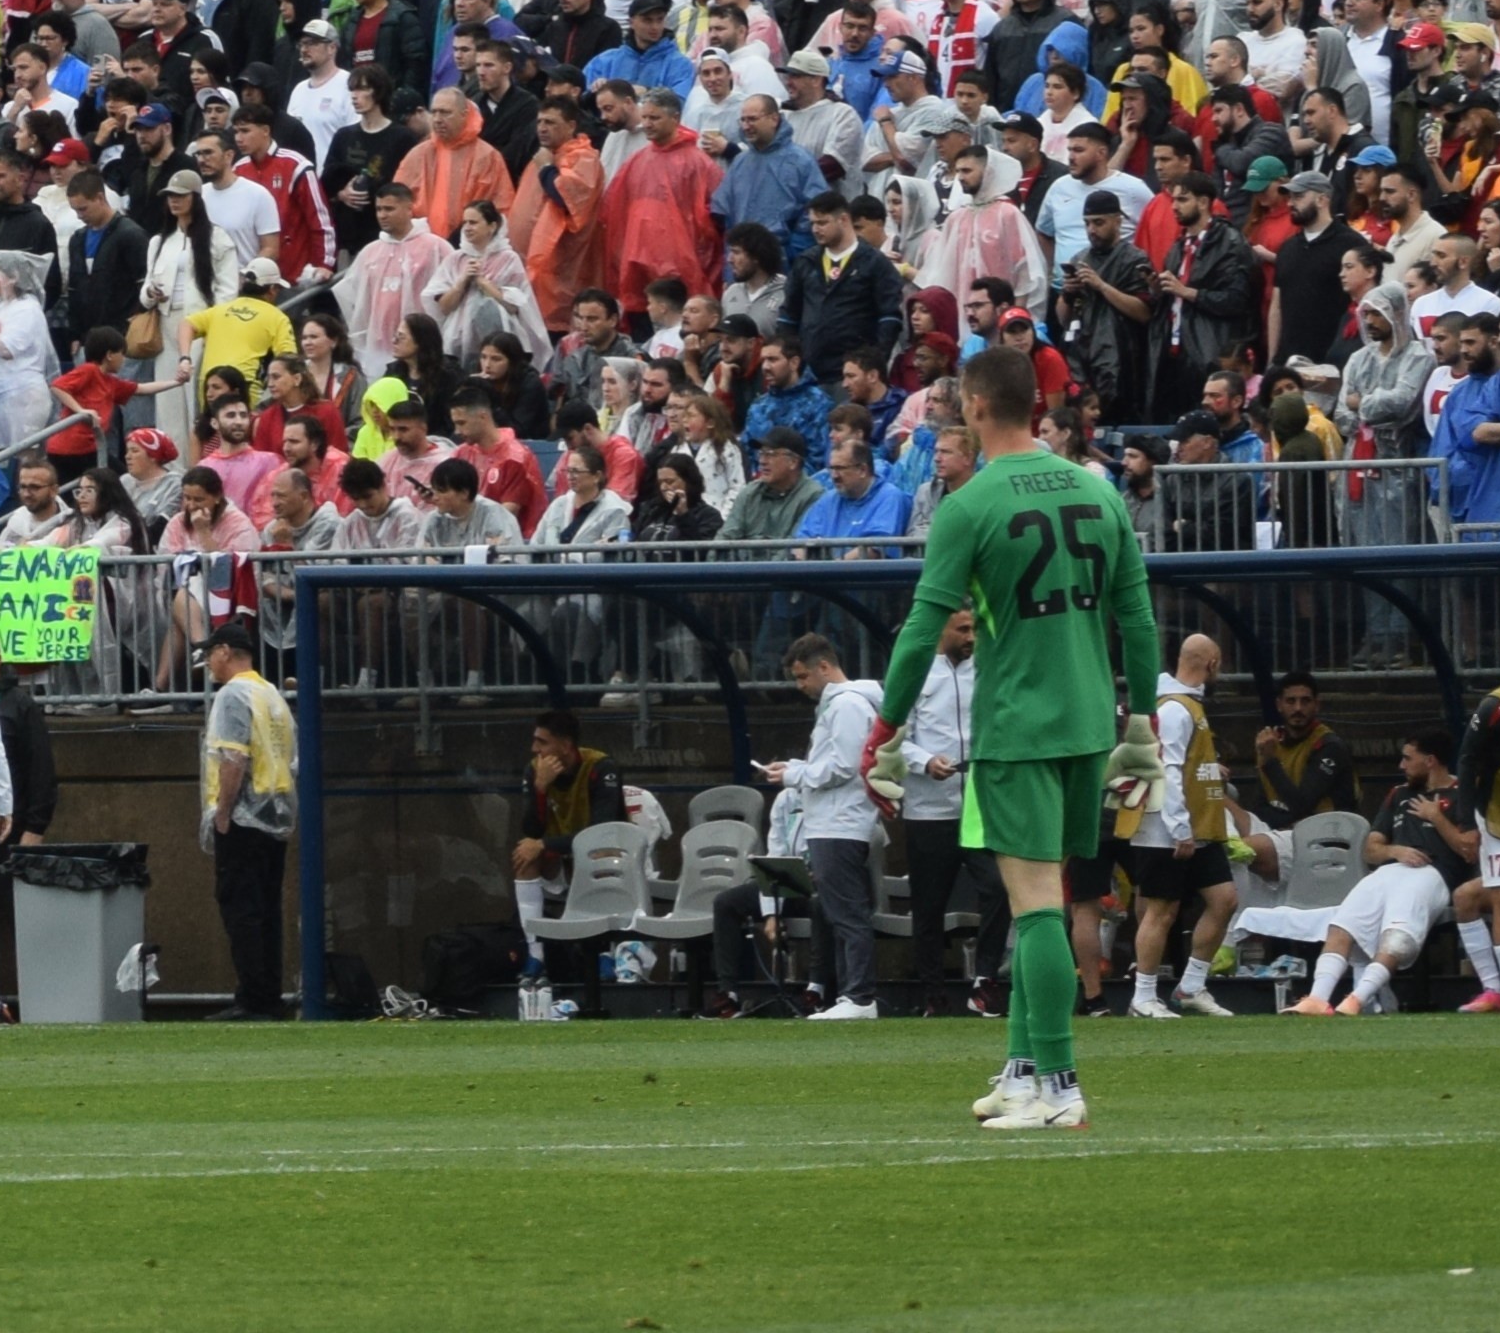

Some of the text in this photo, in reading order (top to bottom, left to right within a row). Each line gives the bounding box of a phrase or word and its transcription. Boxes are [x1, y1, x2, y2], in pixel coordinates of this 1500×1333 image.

[1011, 468, 1080, 496] FREESE
[1007, 504, 1105, 619] 25
[42, 594, 68, 622] I
[37, 627, 80, 644] YOUR
